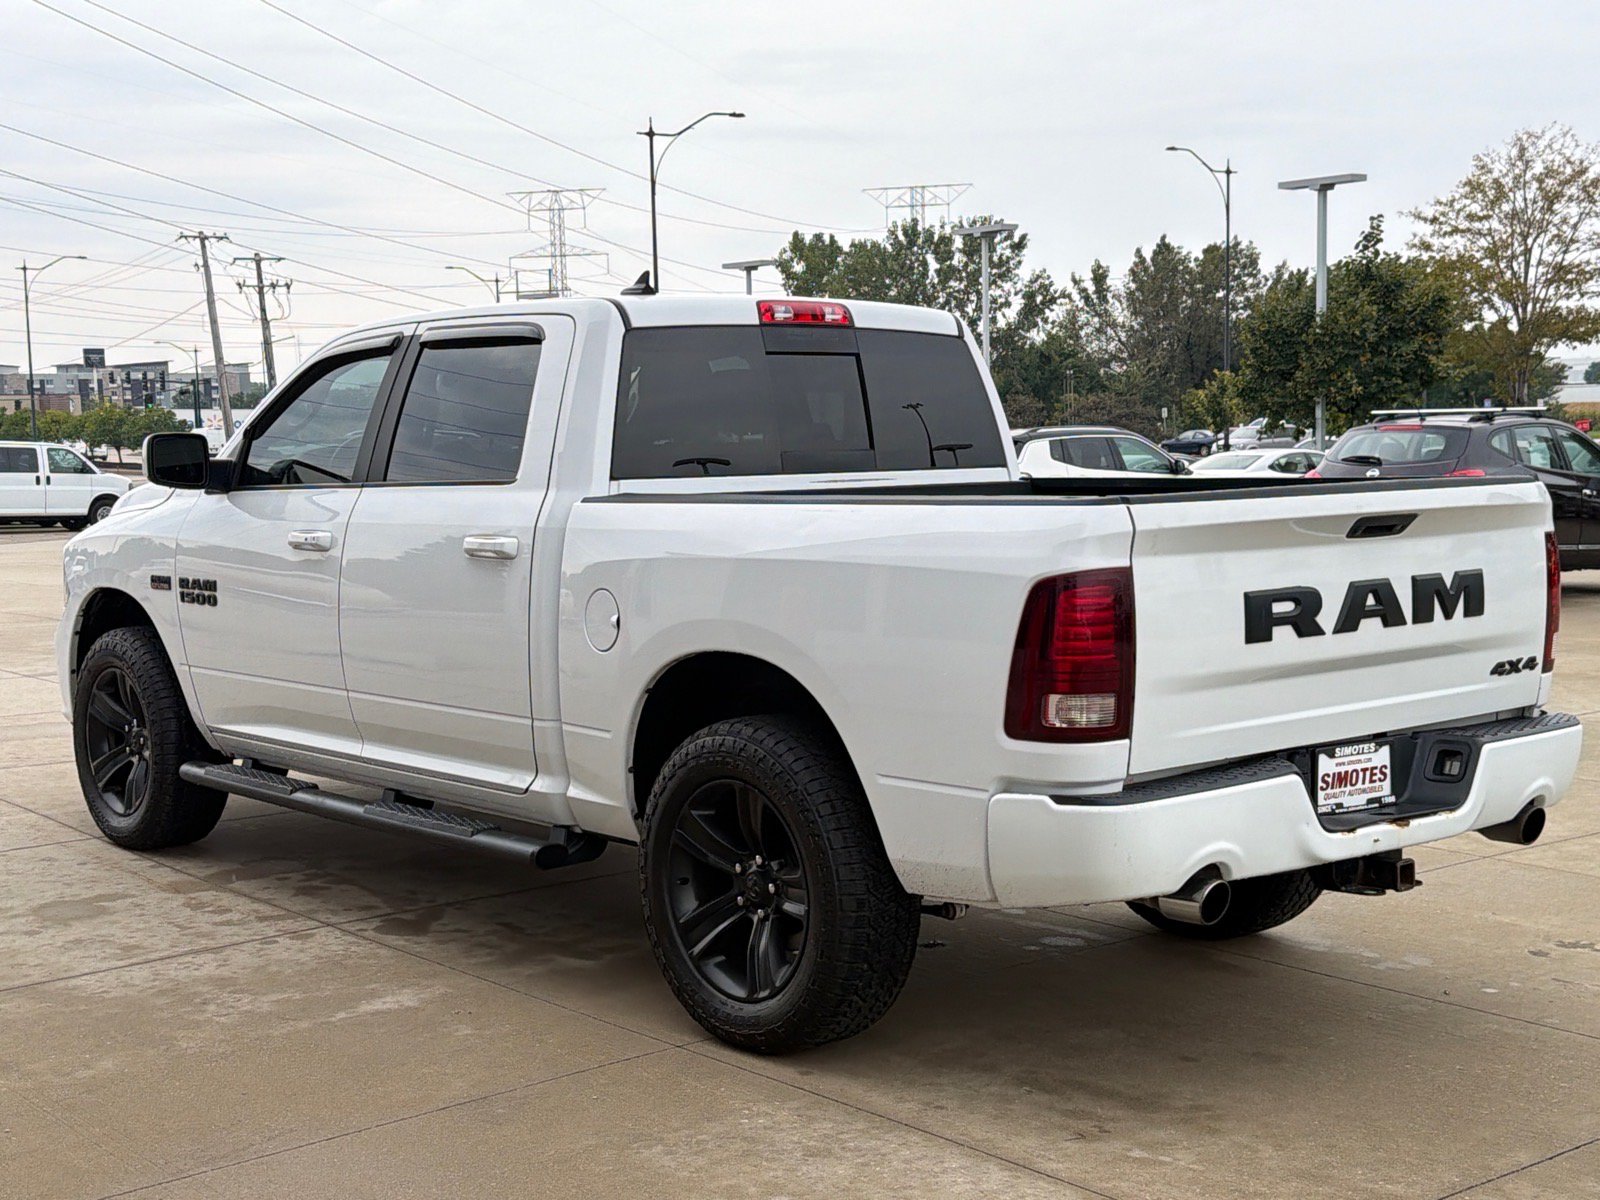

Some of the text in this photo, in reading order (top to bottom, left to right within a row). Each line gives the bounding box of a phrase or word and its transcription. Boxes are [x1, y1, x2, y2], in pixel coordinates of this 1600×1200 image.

[178, 577, 217, 592] RAM
[179, 591, 218, 607] 1500
[1244, 568, 1485, 644] RAM
[1335, 743, 1376, 757] SIMOTES
[1319, 764, 1388, 791] SIMOTES
[1323, 790, 1346, 801] QUALITY
